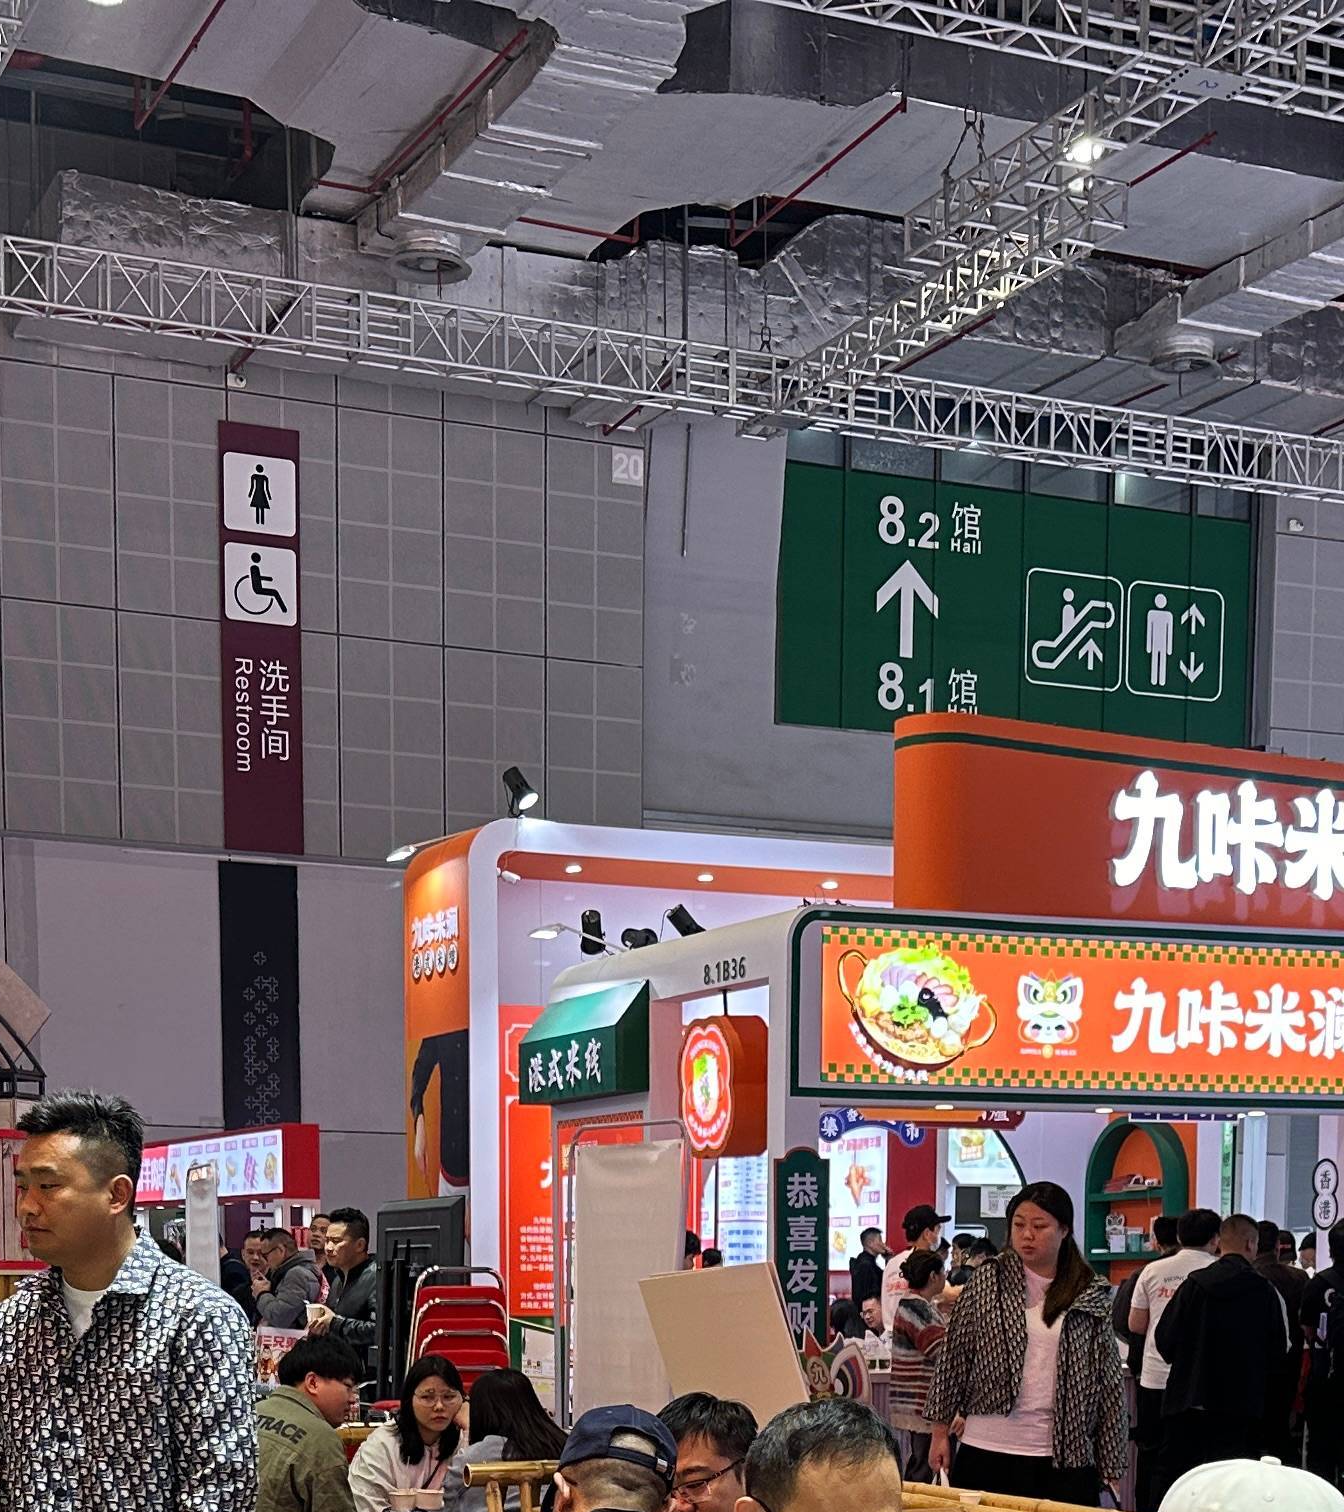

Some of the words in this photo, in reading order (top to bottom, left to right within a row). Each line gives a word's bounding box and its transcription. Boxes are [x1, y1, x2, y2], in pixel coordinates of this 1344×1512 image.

[614, 453, 642, 480] 20
[878, 495, 939, 549] 8.2
[951, 501, 981, 539] 馆
[950, 538, 982, 555] Hall
[258, 659, 291, 762] 洗手间
[878, 661, 934, 713] 8.1
[947, 668, 978, 704] 馆
[234, 656, 252, 773] Restroom
[703, 956, 746, 985] 8.1B36
[528, 1037, 603, 1094] 港式米线
[1319, 1169, 1333, 1220] 香港
[786, 1171, 819, 1335] 恭喜发财
